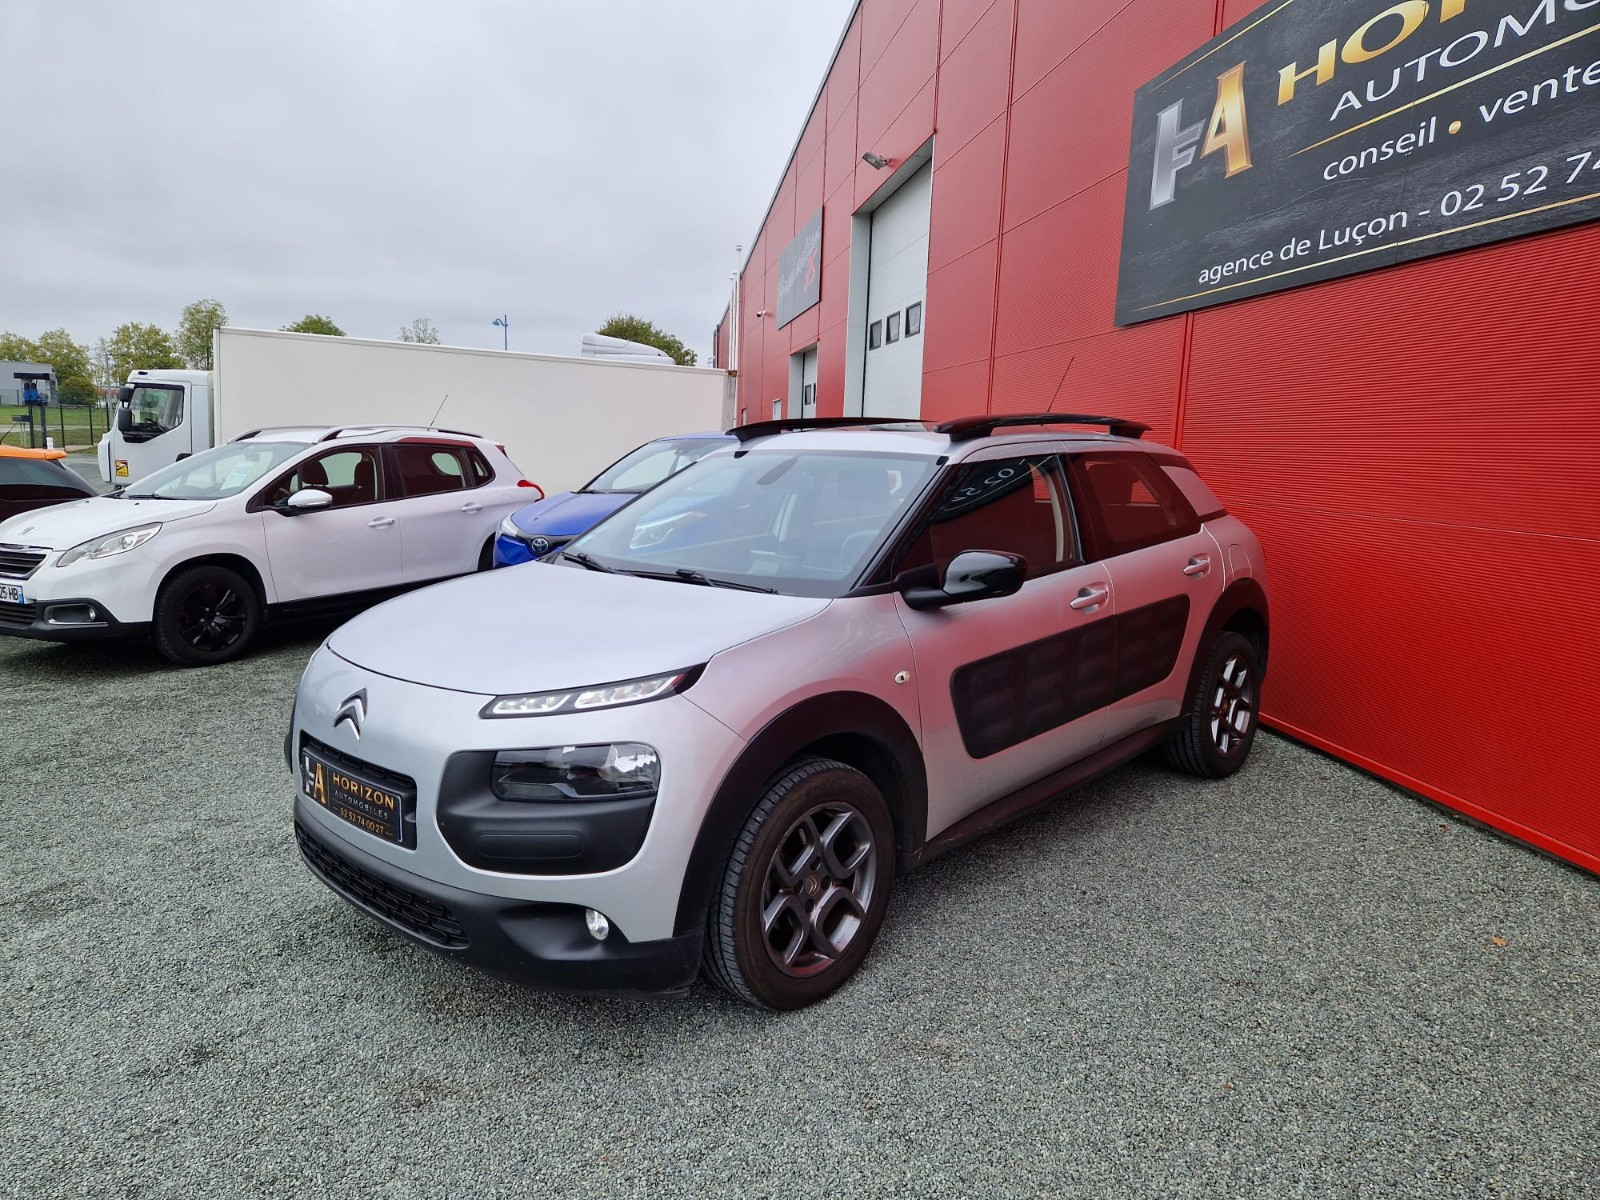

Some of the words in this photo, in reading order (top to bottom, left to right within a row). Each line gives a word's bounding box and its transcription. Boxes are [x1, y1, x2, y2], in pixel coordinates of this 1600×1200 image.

[1329, 0, 1600, 122] AUTOM
[1323, 115, 1437, 181] conseil
[1478, 58, 1600, 123] vente
[1198, 249, 1274, 285] agence
[1279, 237, 1311, 261] de
[1318, 211, 1408, 251] Luçon
[1440, 183, 1485, 216] 02
[1497, 165, 1548, 202] 52
[1566, 151, 1600, 184] 7
[332, 771, 394, 810] HORIZON
[334, 790, 388, 820] AUTOMOBILES
[340, 807, 348, 818] 02
[357, 815, 365, 826] 74
[375, 824, 384, 835] 27
